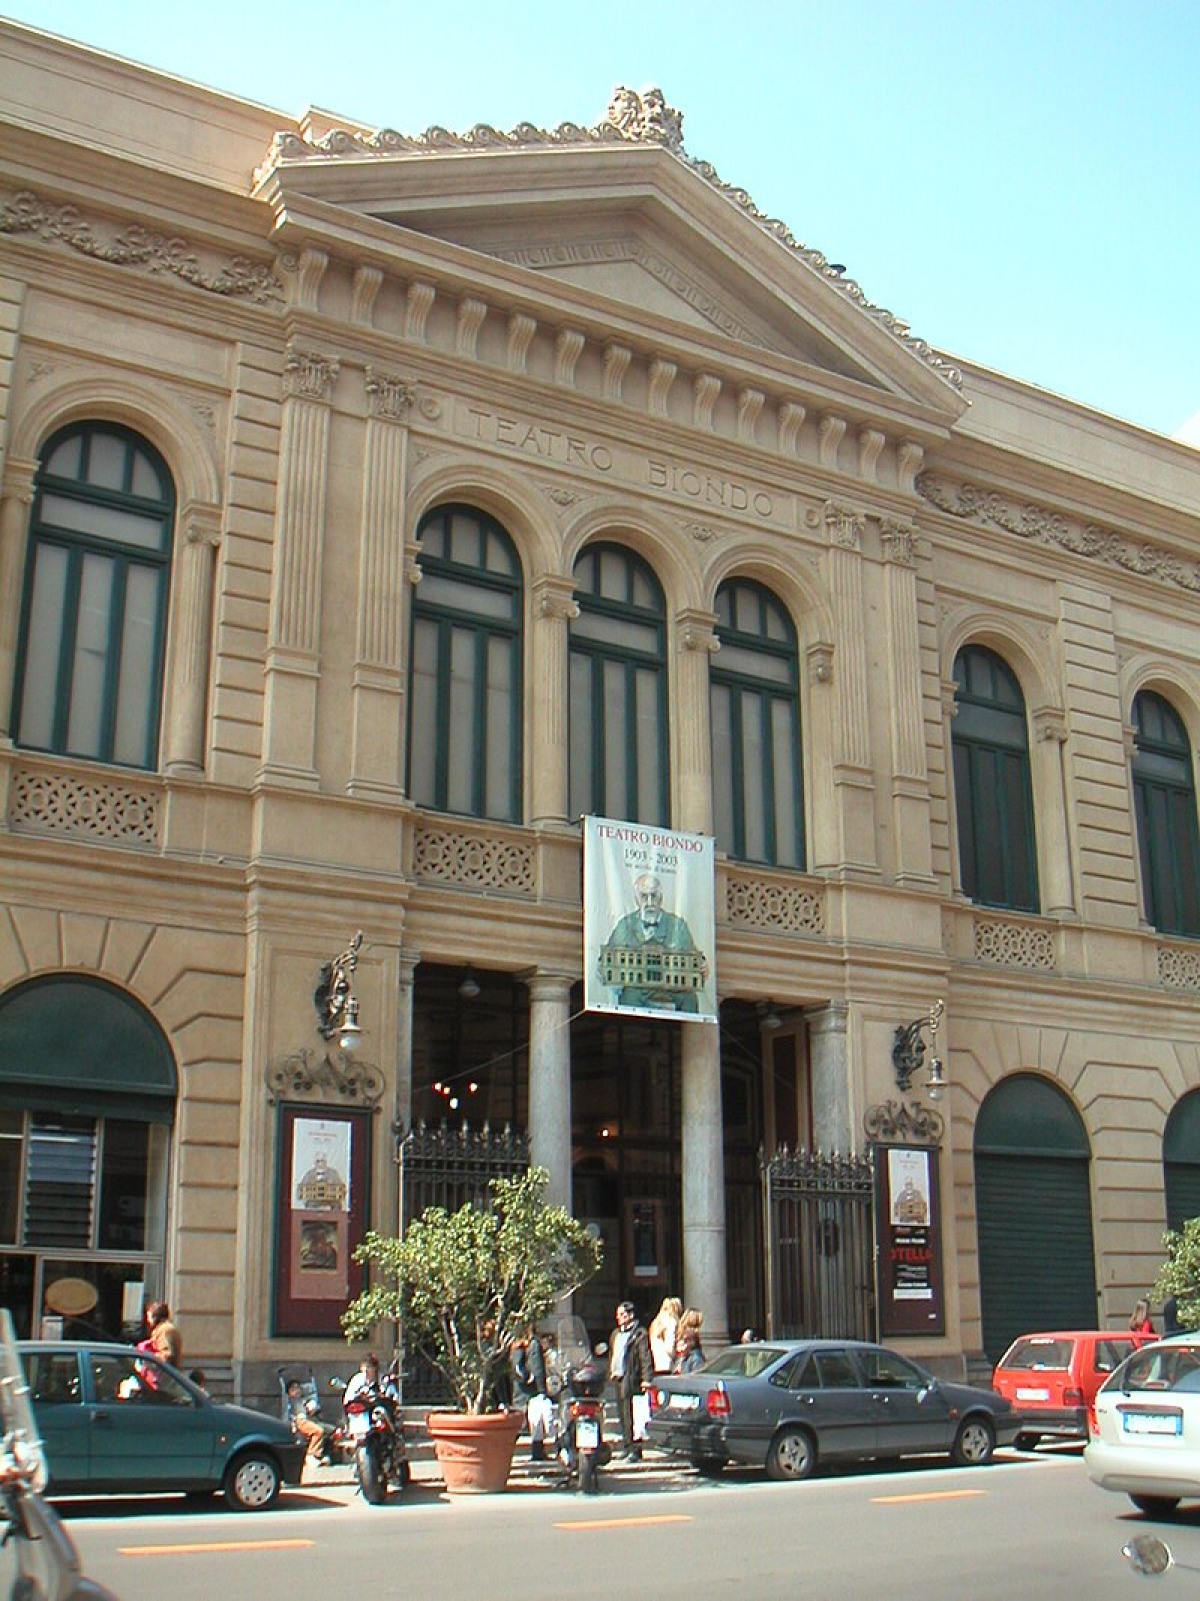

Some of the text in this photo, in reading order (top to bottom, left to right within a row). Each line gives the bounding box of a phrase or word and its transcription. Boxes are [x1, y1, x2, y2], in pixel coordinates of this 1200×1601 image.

[468, 408, 773, 517] TEATRO BIONDO
[598, 825, 703, 852] TEATRO BIONDO
[624, 848, 648, 861] 1903
